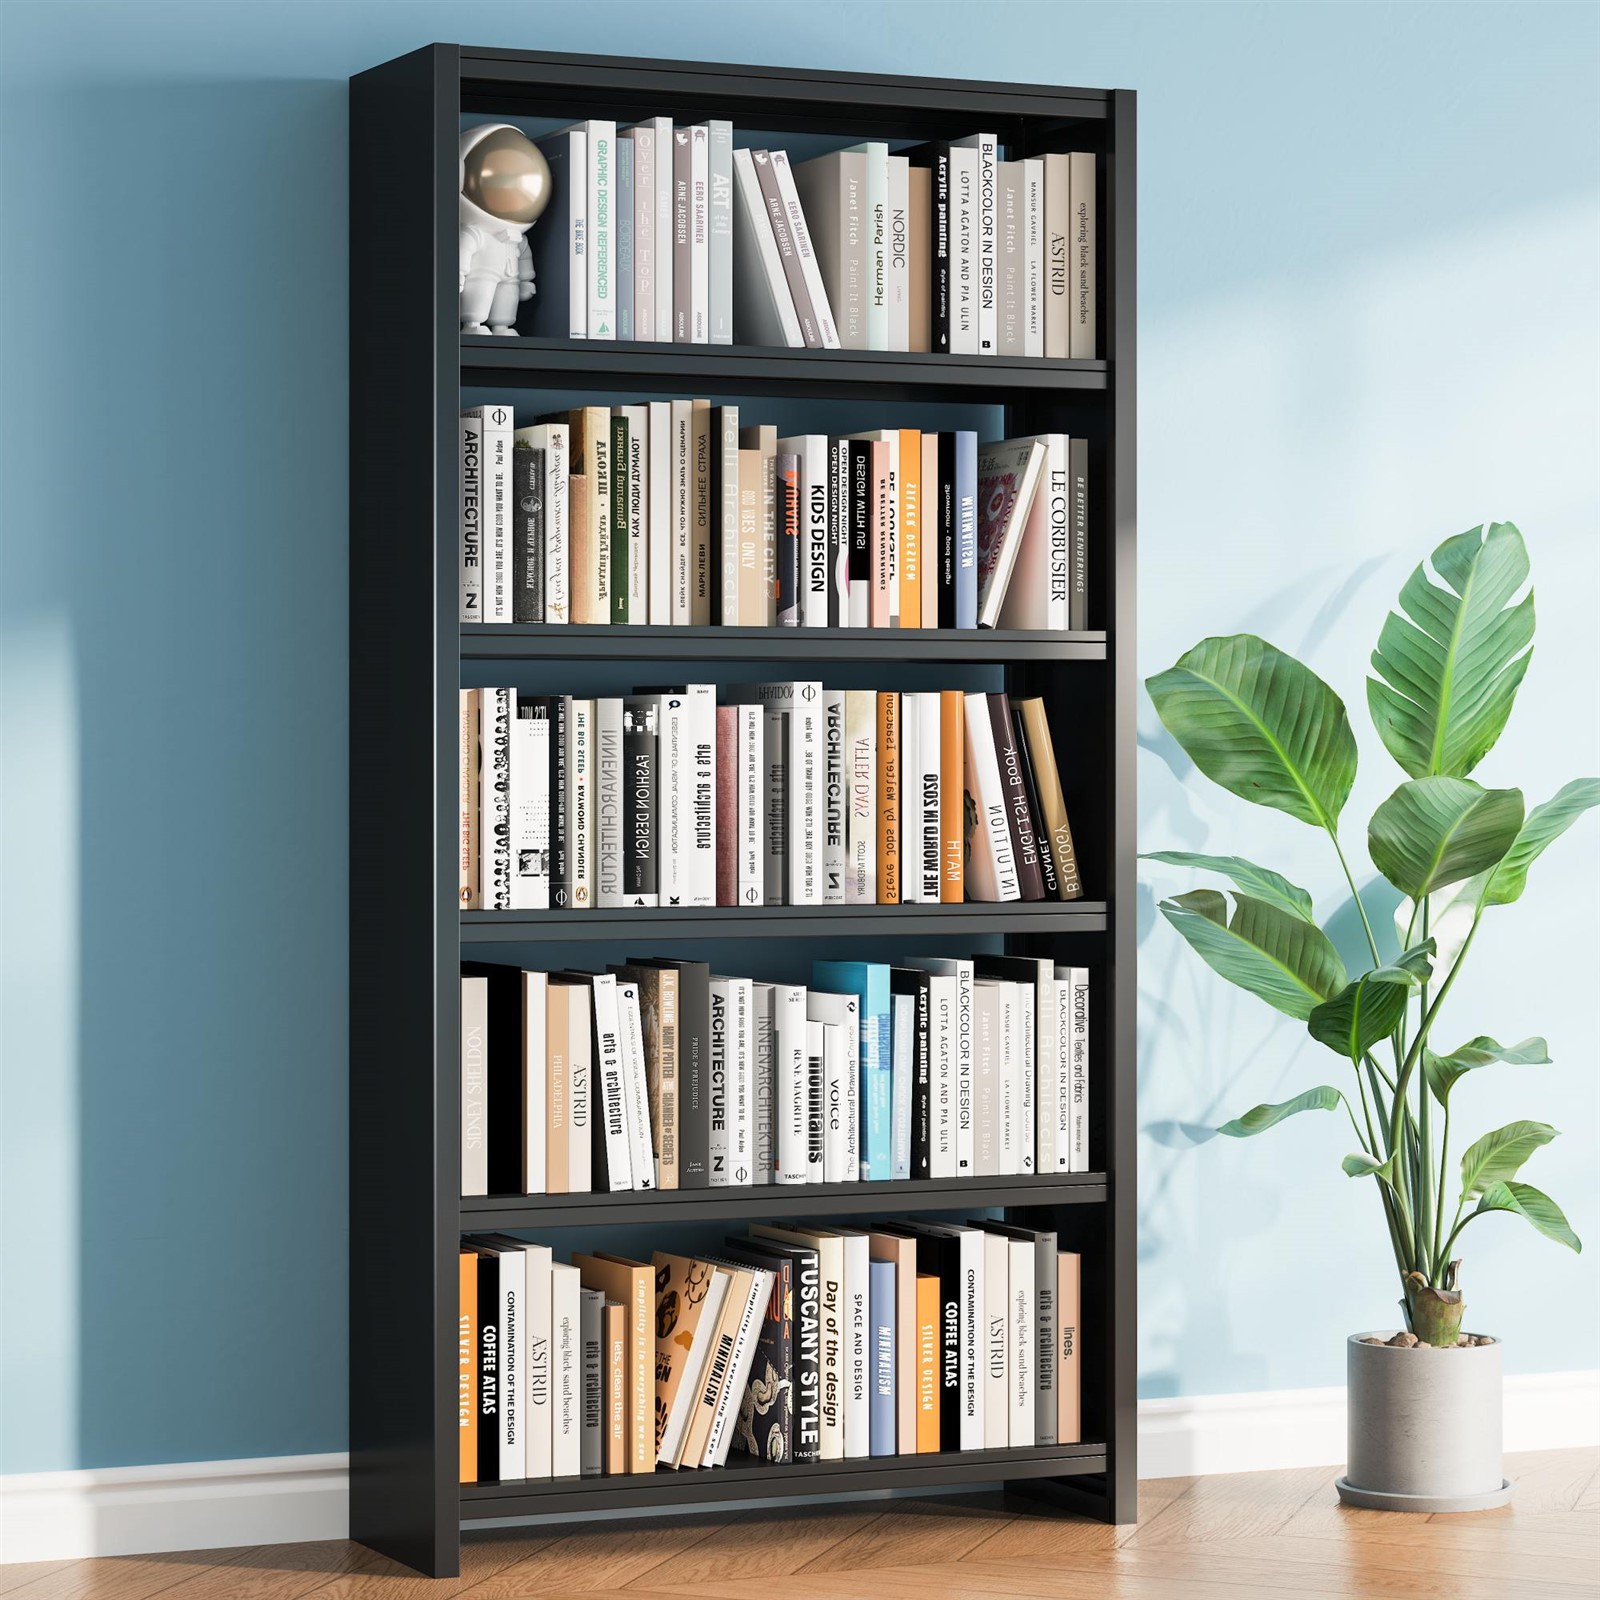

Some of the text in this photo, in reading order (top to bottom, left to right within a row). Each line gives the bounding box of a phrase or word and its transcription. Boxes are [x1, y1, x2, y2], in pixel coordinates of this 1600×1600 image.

[597, 139, 608, 186] GRAPHIC
[597, 189, 608, 228] DESIGN
[713, 173, 730, 209] ART
[938, 156, 947, 258] Acrylic painting
[678, 181, 686, 244] ARNE JACOBSEN
[695, 181, 704, 243] EERO SAARINEN
[768, 198, 792, 256] ARNE JACOBSEN
[788, 201, 811, 258] EERO SAARINEN
[874, 204, 883, 306] Herman Parish
[892, 209, 905, 268] NORDIC
[961, 171, 970, 331] LOTTA AGATON AND PIA ULIN
[982, 143, 993, 309] BLACKCOLOR IN DESIGN
[597, 231, 608, 299] REFERENCED
[1031, 261, 1036, 270] LA
[1052, 233, 1065, 295] ÆSTRID
[1077, 202, 1089, 324] exploring black sand beaches
[464, 430, 478, 567] ARCHITECTURE
[631, 437, 640, 538] КАК ЛЮДИ ДУМАЮТ
[698, 434, 706, 527] СИЛЬНЕЕ СТРАХА
[724, 414, 738, 615] Pelli Architects
[1077, 477, 1084, 488] BE
[763, 488, 774, 583] IN THE CITY
[811, 485, 825, 592] KIDS DESIGN
[1051, 471, 1066, 601] LE CORBUSIER
[603, 1033, 617, 1054] arts
[712, 994, 725, 1131] ARCHITECTURE
[919, 986, 928, 1084] Acrylic painting
[960, 971, 970, 1129] BLACKCOLOR IN DESIGN
[1060, 1072, 1066, 1083] IN
[1074, 984, 1089, 1103] Decorative Textiles and Fabrics
[553, 1055, 563, 1128] PHILADELPHIA
[604, 1071, 622, 1135] architecture
[691, 1069, 699, 1110] PREJUDICE
[758, 1016, 772, 1172] INNENARCHITEKTUR
[808, 1056, 823, 1163] mountains
[830, 1079, 841, 1130] voice
[483, 1325, 496, 1414] COFFEE ATLAS
[507, 1291, 515, 1445] CONTAMINATION OF THE DESIGN
[560, 1317, 573, 1434] exploring black sand beaches
[612, 1341, 624, 1439] lets, clean the air
[703, 1334, 733, 1407] MINIMALISM
[707, 1283, 761, 1454] simplicity is in everything we see
[801, 1253, 818, 1444] TUSCANY STYLE
[823, 1281, 839, 1427] Day of the design
[854, 1294, 862, 1400] SPACE AND DESIGN
[877, 1326, 891, 1395] MINIMALISM
[922, 1325, 933, 1410] SILVER DESIGN
[945, 1302, 958, 1387] COFFEE ATLAS
[1063, 1327, 1075, 1360] lines.
